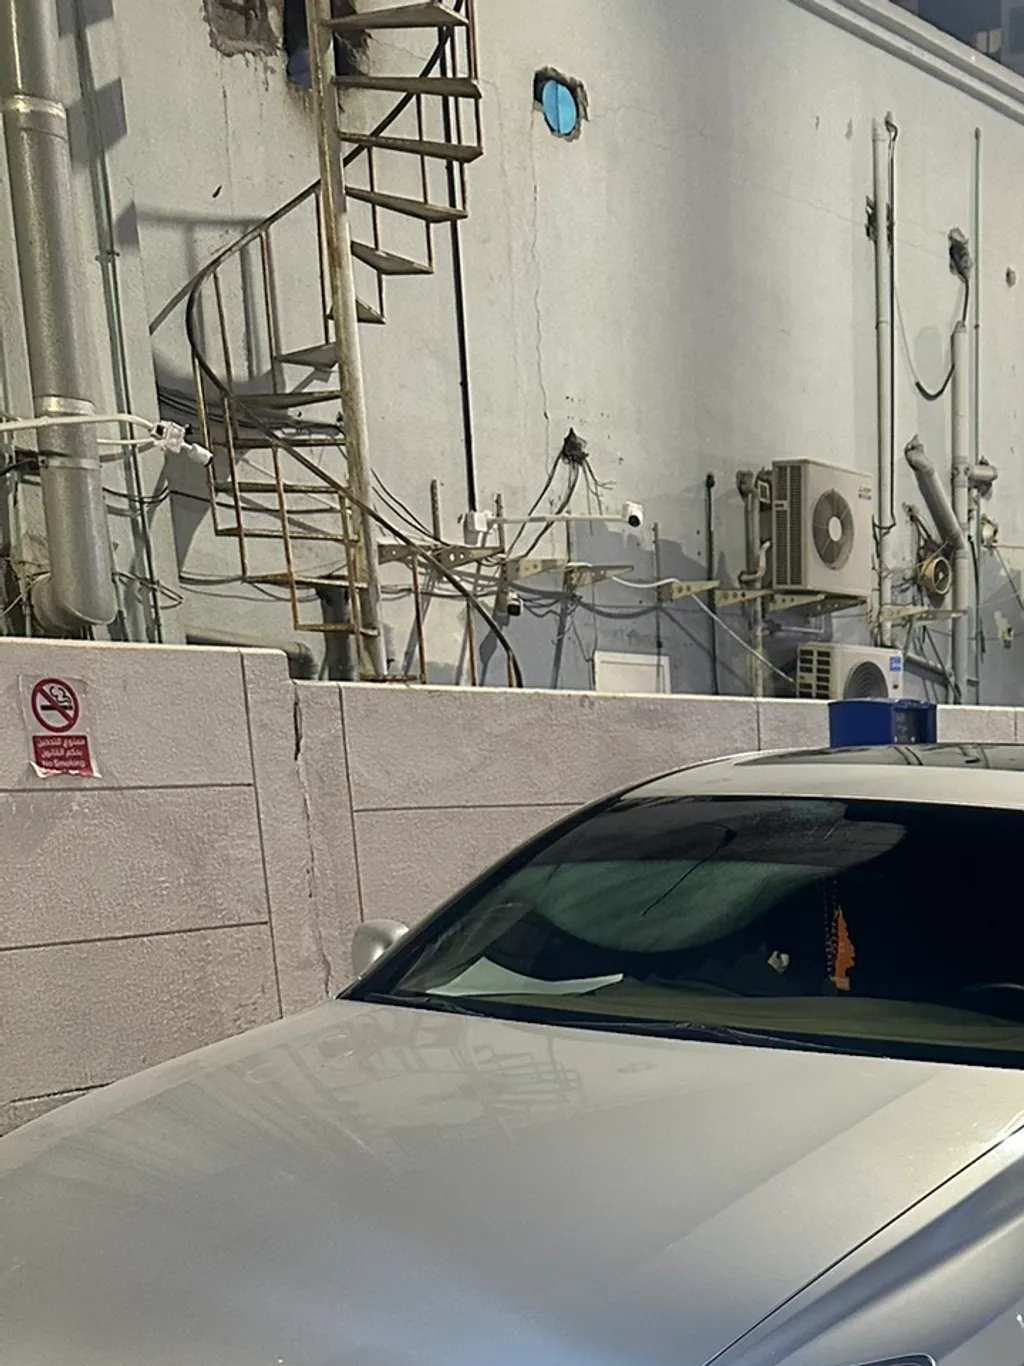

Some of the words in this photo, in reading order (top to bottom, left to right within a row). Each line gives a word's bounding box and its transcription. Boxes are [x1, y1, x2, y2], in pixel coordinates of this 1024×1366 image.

[37, 738, 62, 747] التدخين
[63, 739, 85, 748] ممنوع
[53, 759, 85, 767] Smoking
